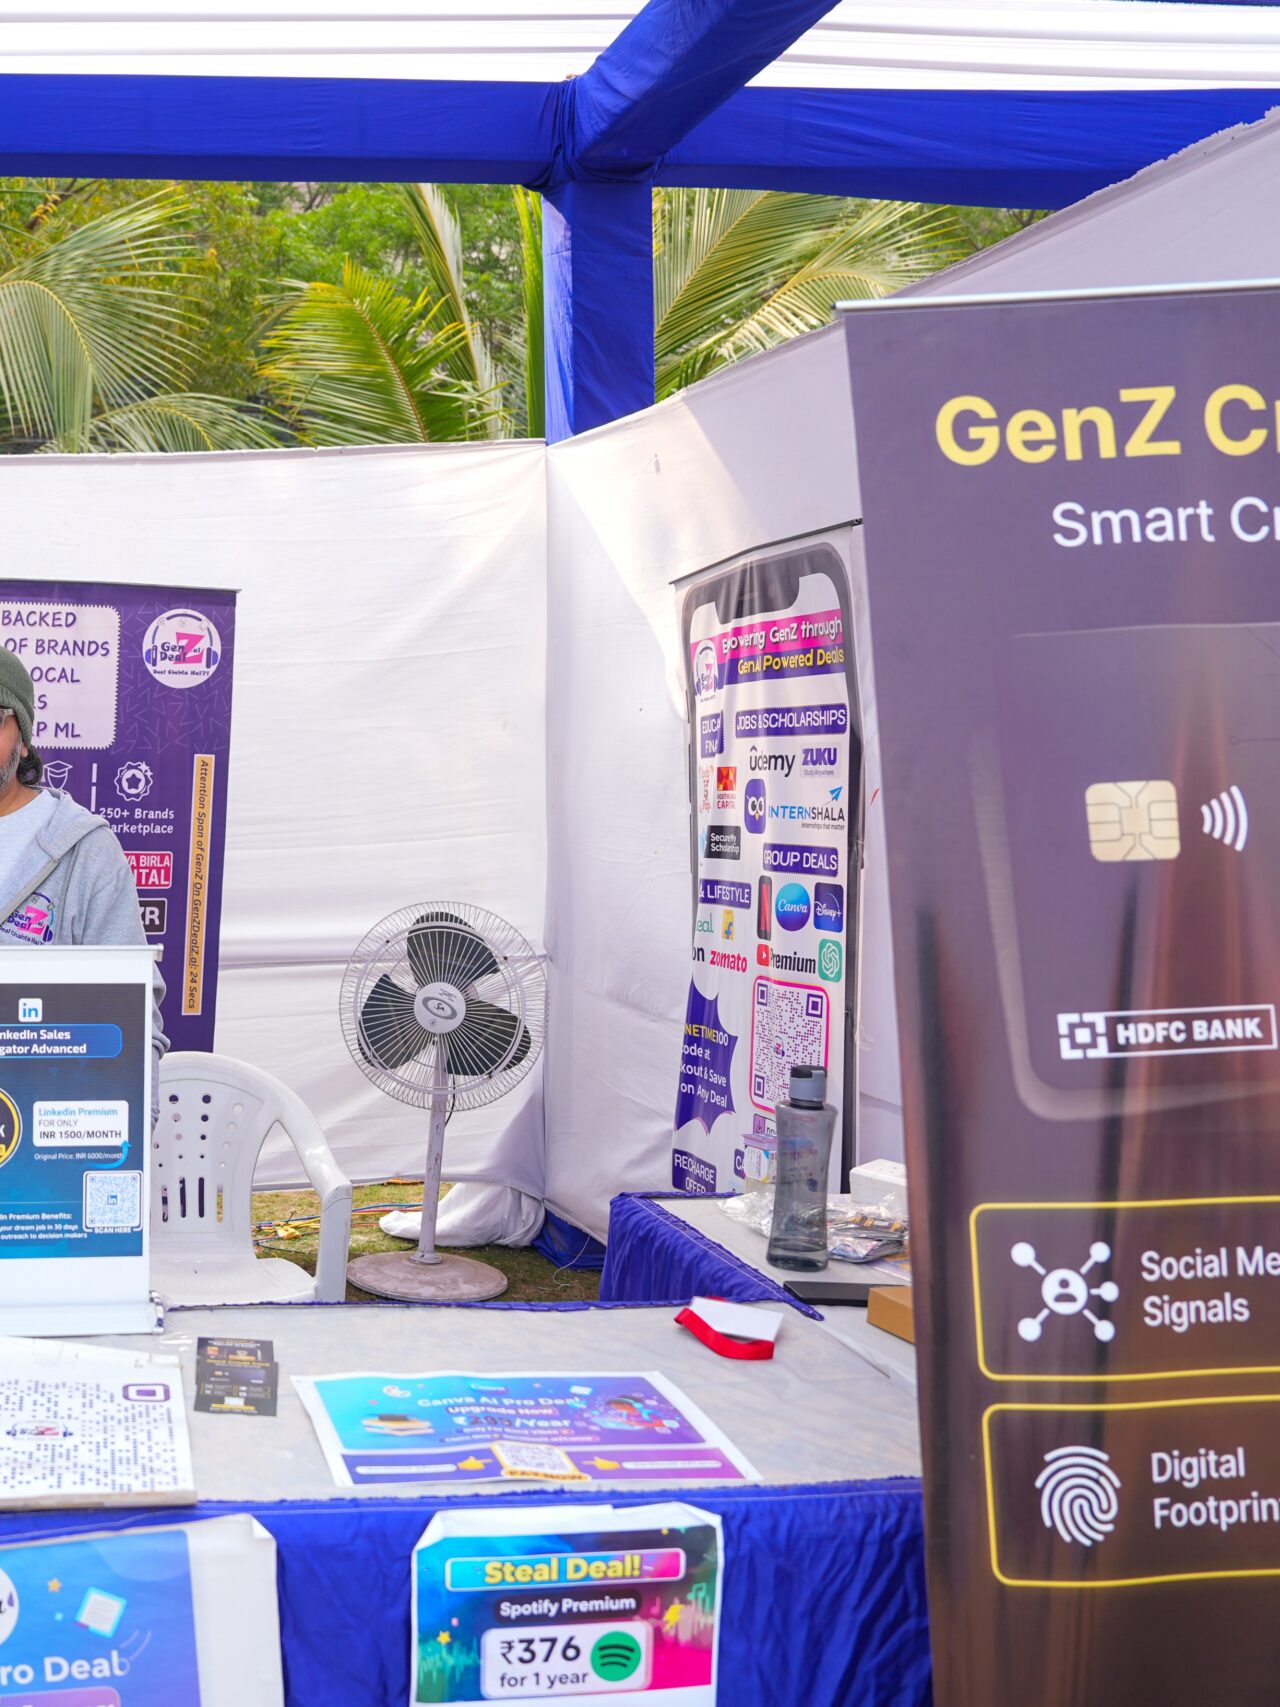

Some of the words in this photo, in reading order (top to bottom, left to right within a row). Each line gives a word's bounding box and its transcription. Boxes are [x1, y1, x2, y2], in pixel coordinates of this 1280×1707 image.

[935, 386, 1181, 466] GenZ
[1052, 500, 1216, 547] Smart
[2, 610, 76, 628] BACKED
[770, 623, 797, 643] GenZ
[801, 617, 842, 640] through
[4, 637, 28, 654] OF
[35, 640, 110, 657] BRANDS
[763, 649, 813, 671] Powered
[817, 648, 844, 666] Deals
[30, 666, 81, 683] OCAL
[54, 721, 81, 738] ML
[737, 713, 757, 730] JOBS
[763, 709, 846, 728] SCHOLARSHIPS
[802, 747, 838, 766] ZUKU
[198, 759, 209, 809] Attention
[100, 808, 130, 819] 250+
[135, 808, 175, 820] Brands
[769, 805, 845, 822] INTERNSHALA
[110, 823, 174, 835] arketplace
[196, 812, 206, 839] Span
[196, 841, 204, 853] of
[139, 855, 170, 867] BIRLA
[195, 854, 205, 880] GenZ
[764, 850, 800, 867] GROUP
[803, 855, 838, 871] DEALS
[193, 882, 203, 897] On
[707, 884, 750, 904] LIFESTYLE
[777, 899, 808, 913] Canva
[710, 950, 747, 973] zomato
[189, 971, 198, 984] 24
[188, 986, 197, 1009] Secs
[22, 1002, 39, 1018] in
[40, 1029, 71, 1040] Sales
[1116, 1020, 1186, 1045] HDFC
[1193, 1017, 1262, 1041] BANK
[31, 1043, 87, 1054] Advanced
[709, 1069, 727, 1087] Save
[681, 1083, 695, 1095] on
[697, 1084, 710, 1103] Any
[710, 1090, 728, 1108] Deal
[78, 1107, 118, 1117] Premium
[39, 1120, 55, 1128] FOR
[57, 1119, 78, 1127] ONLY
[39, 1131, 56, 1139] INR
[59, 1130, 121, 1140] 1500/MONTH
[34, 1153, 56, 1161] Original
[674, 1154, 715, 1184] RECHARGE
[35, 1224, 46, 1232] job
[1140, 1247, 1228, 1282] Social
[1236, 1245, 1280, 1276] Me
[1143, 1291, 1251, 1333] Signals
[417, 1397, 475, 1408] Canva
[502, 1397, 535, 1406] Pro
[1151, 1447, 1245, 1488] Digital
[1153, 1490, 1280, 1532] Footprin
[484, 1557, 558, 1584] Steal
[565, 1554, 641, 1580] Deal!
[499, 1600, 559, 1618] Spotify
[562, 1596, 637, 1613] Premium
[499, 1635, 581, 1665] ₹376
[44, 1650, 129, 1683] Deal
[500, 1671, 526, 1688] for
[533, 1672, 540, 1686] 1
[546, 1671, 589, 1689] year
